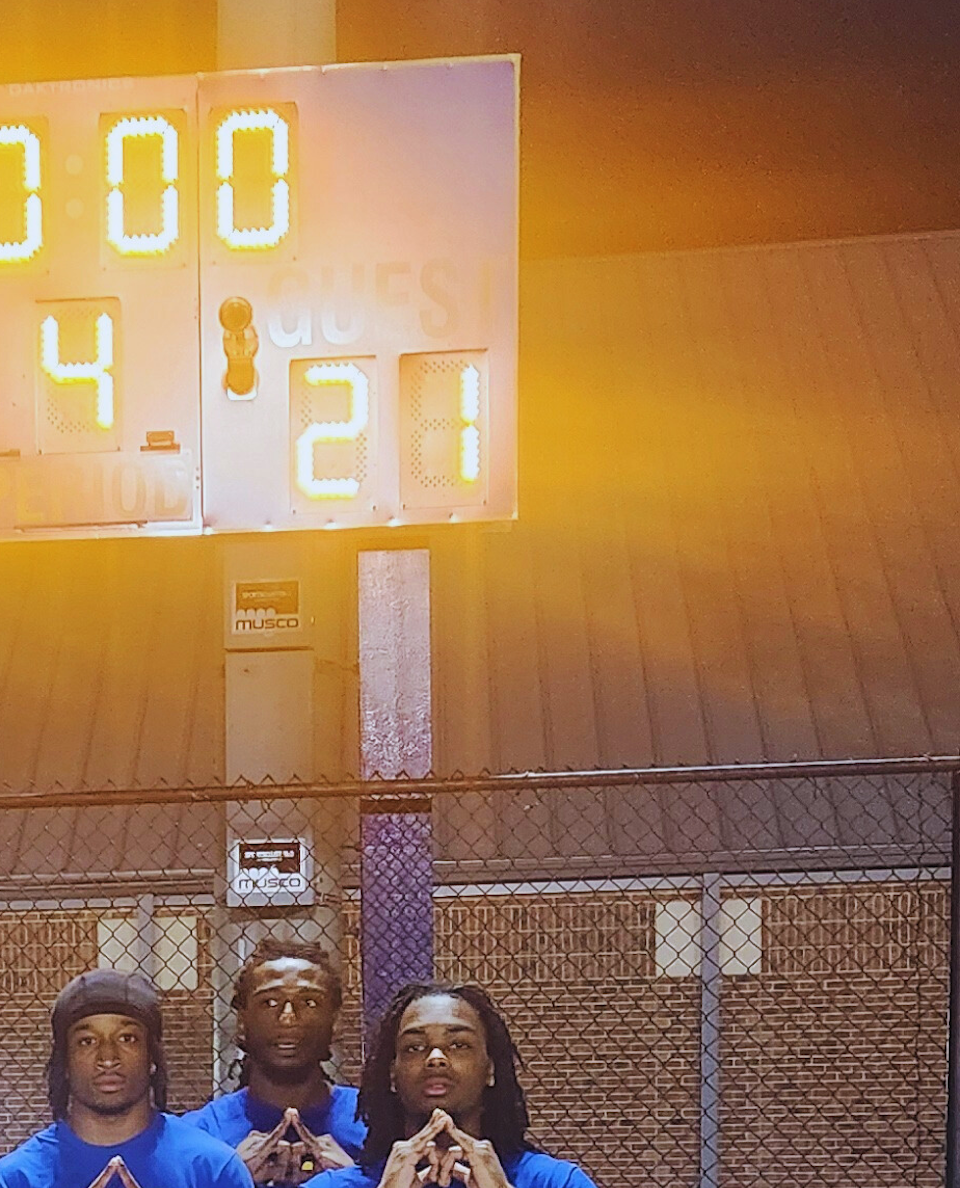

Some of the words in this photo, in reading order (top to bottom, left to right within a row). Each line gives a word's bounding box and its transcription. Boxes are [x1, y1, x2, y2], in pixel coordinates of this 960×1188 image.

[266, 253, 508, 348] GUEST
[41, 311, 115, 431] 4
[296, 361, 481, 498] 21
[236, 618, 298, 630] MUSCO
